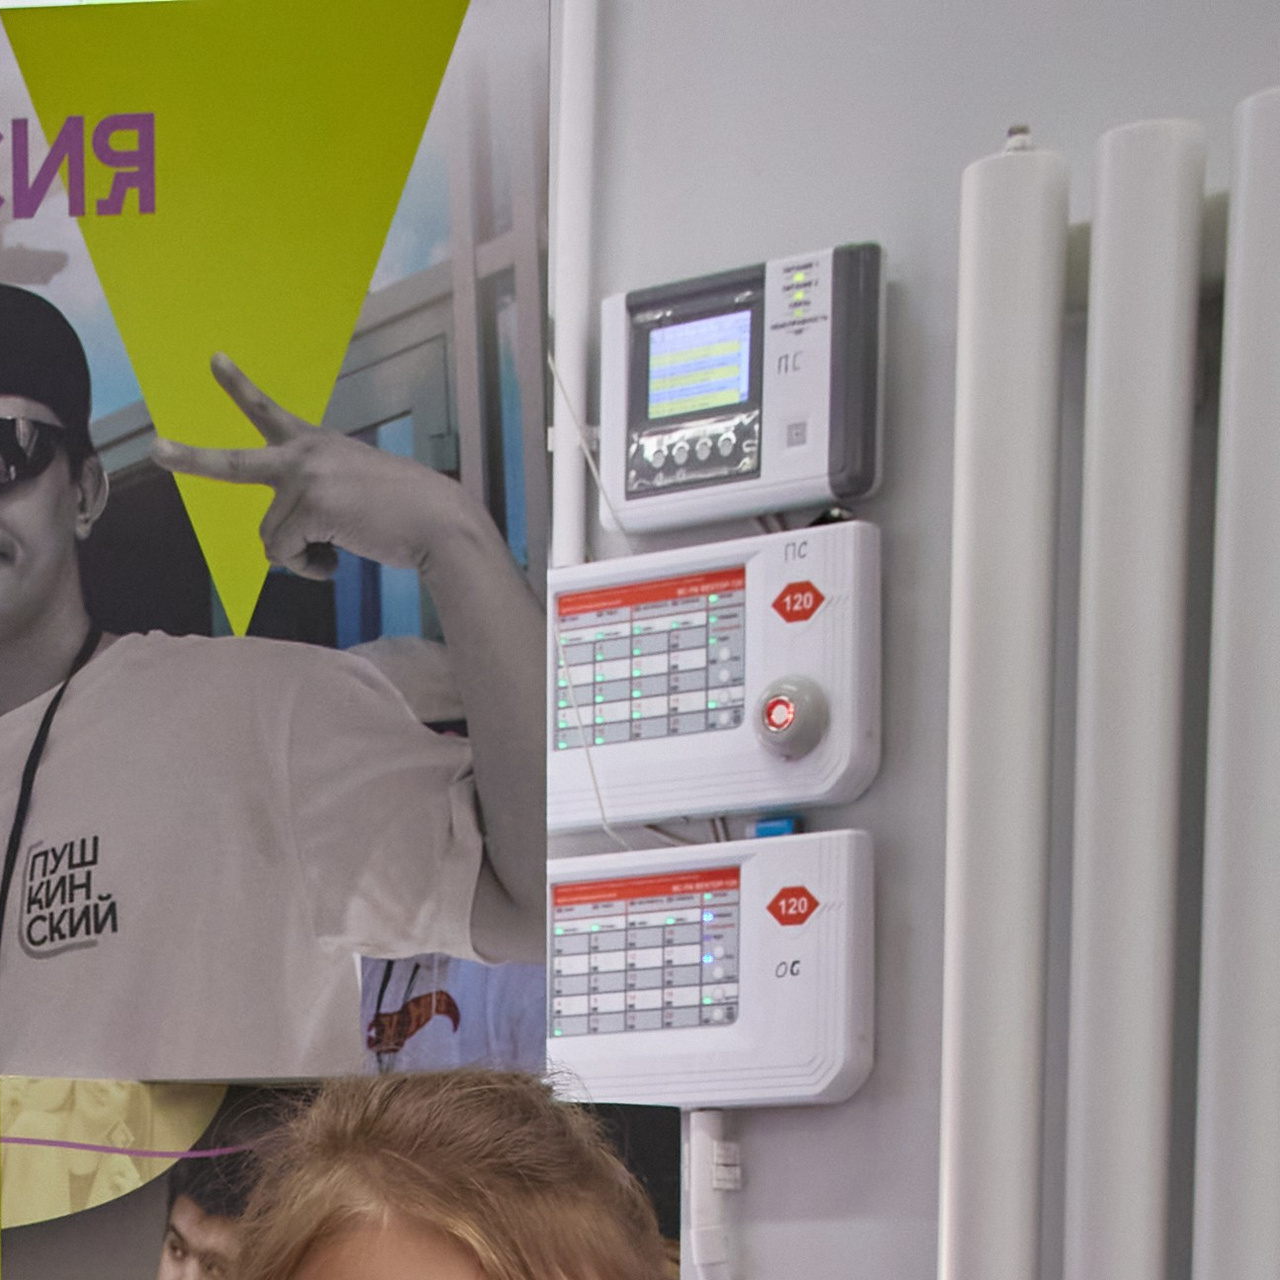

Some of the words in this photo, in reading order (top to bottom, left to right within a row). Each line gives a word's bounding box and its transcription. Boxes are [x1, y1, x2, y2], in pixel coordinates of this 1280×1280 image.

[783, 591, 814, 611] 120
[28, 836, 99, 882] ПУШ
[27, 870, 92, 913] КИН
[778, 896, 809, 916] 120
[26, 893, 118, 947] СКИЙ
